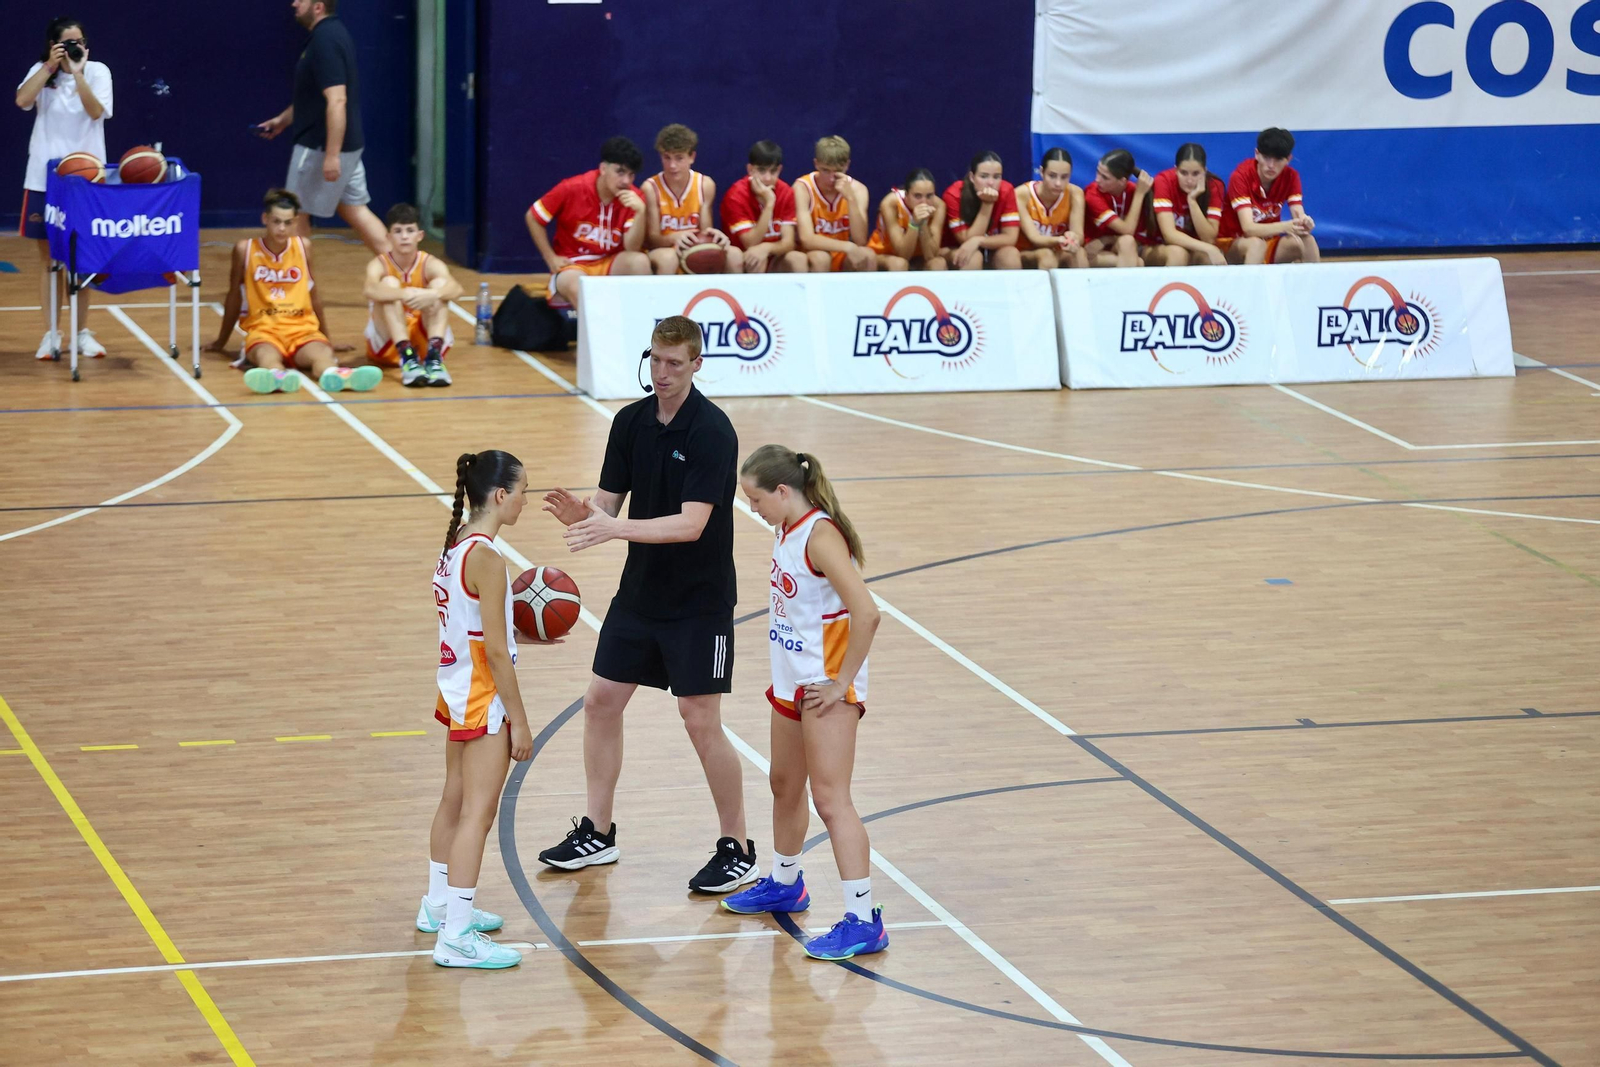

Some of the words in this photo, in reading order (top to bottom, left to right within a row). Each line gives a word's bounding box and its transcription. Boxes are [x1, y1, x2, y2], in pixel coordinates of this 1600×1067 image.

[91, 214, 182, 238] molten
[254, 266, 302, 283] PALO
[865, 324, 881, 337] EL
[1120, 309, 1236, 352] PALO
[1131, 320, 1146, 333] EL
[1317, 302, 1430, 347] PALO
[1327, 315, 1342, 328] EL
[853, 313, 973, 357] PALO
